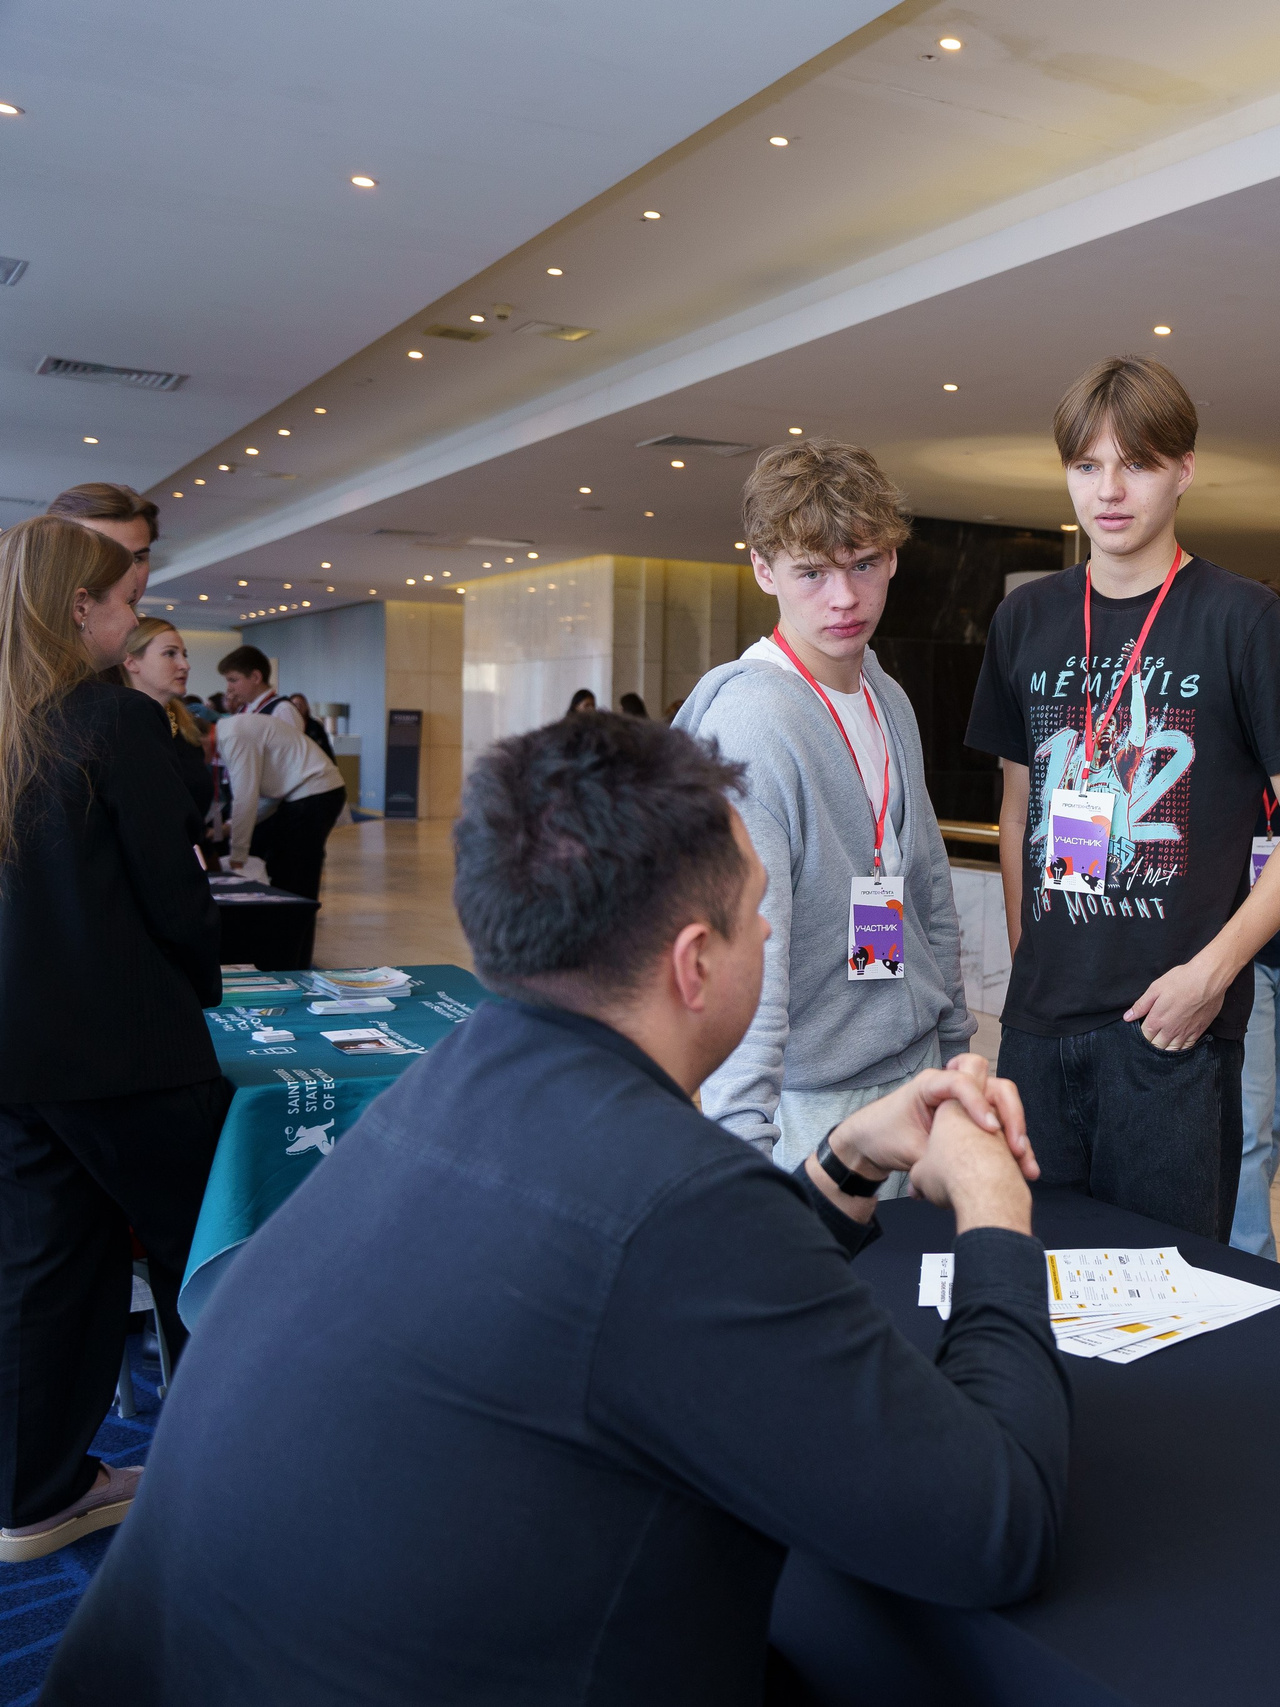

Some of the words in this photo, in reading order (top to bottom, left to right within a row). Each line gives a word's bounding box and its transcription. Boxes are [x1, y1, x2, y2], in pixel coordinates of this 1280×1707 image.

[1066, 656, 1165, 672] GRIZZES
[1054, 835, 1102, 848] УЧАСТНИК
[1063, 890, 1165, 925] MORANT
[855, 924, 898, 932] УЧАСТНИК
[287, 1081, 300, 1115] SAINT
[305, 1079, 318, 1113] STATE
[323, 1094, 335, 1110] OF
